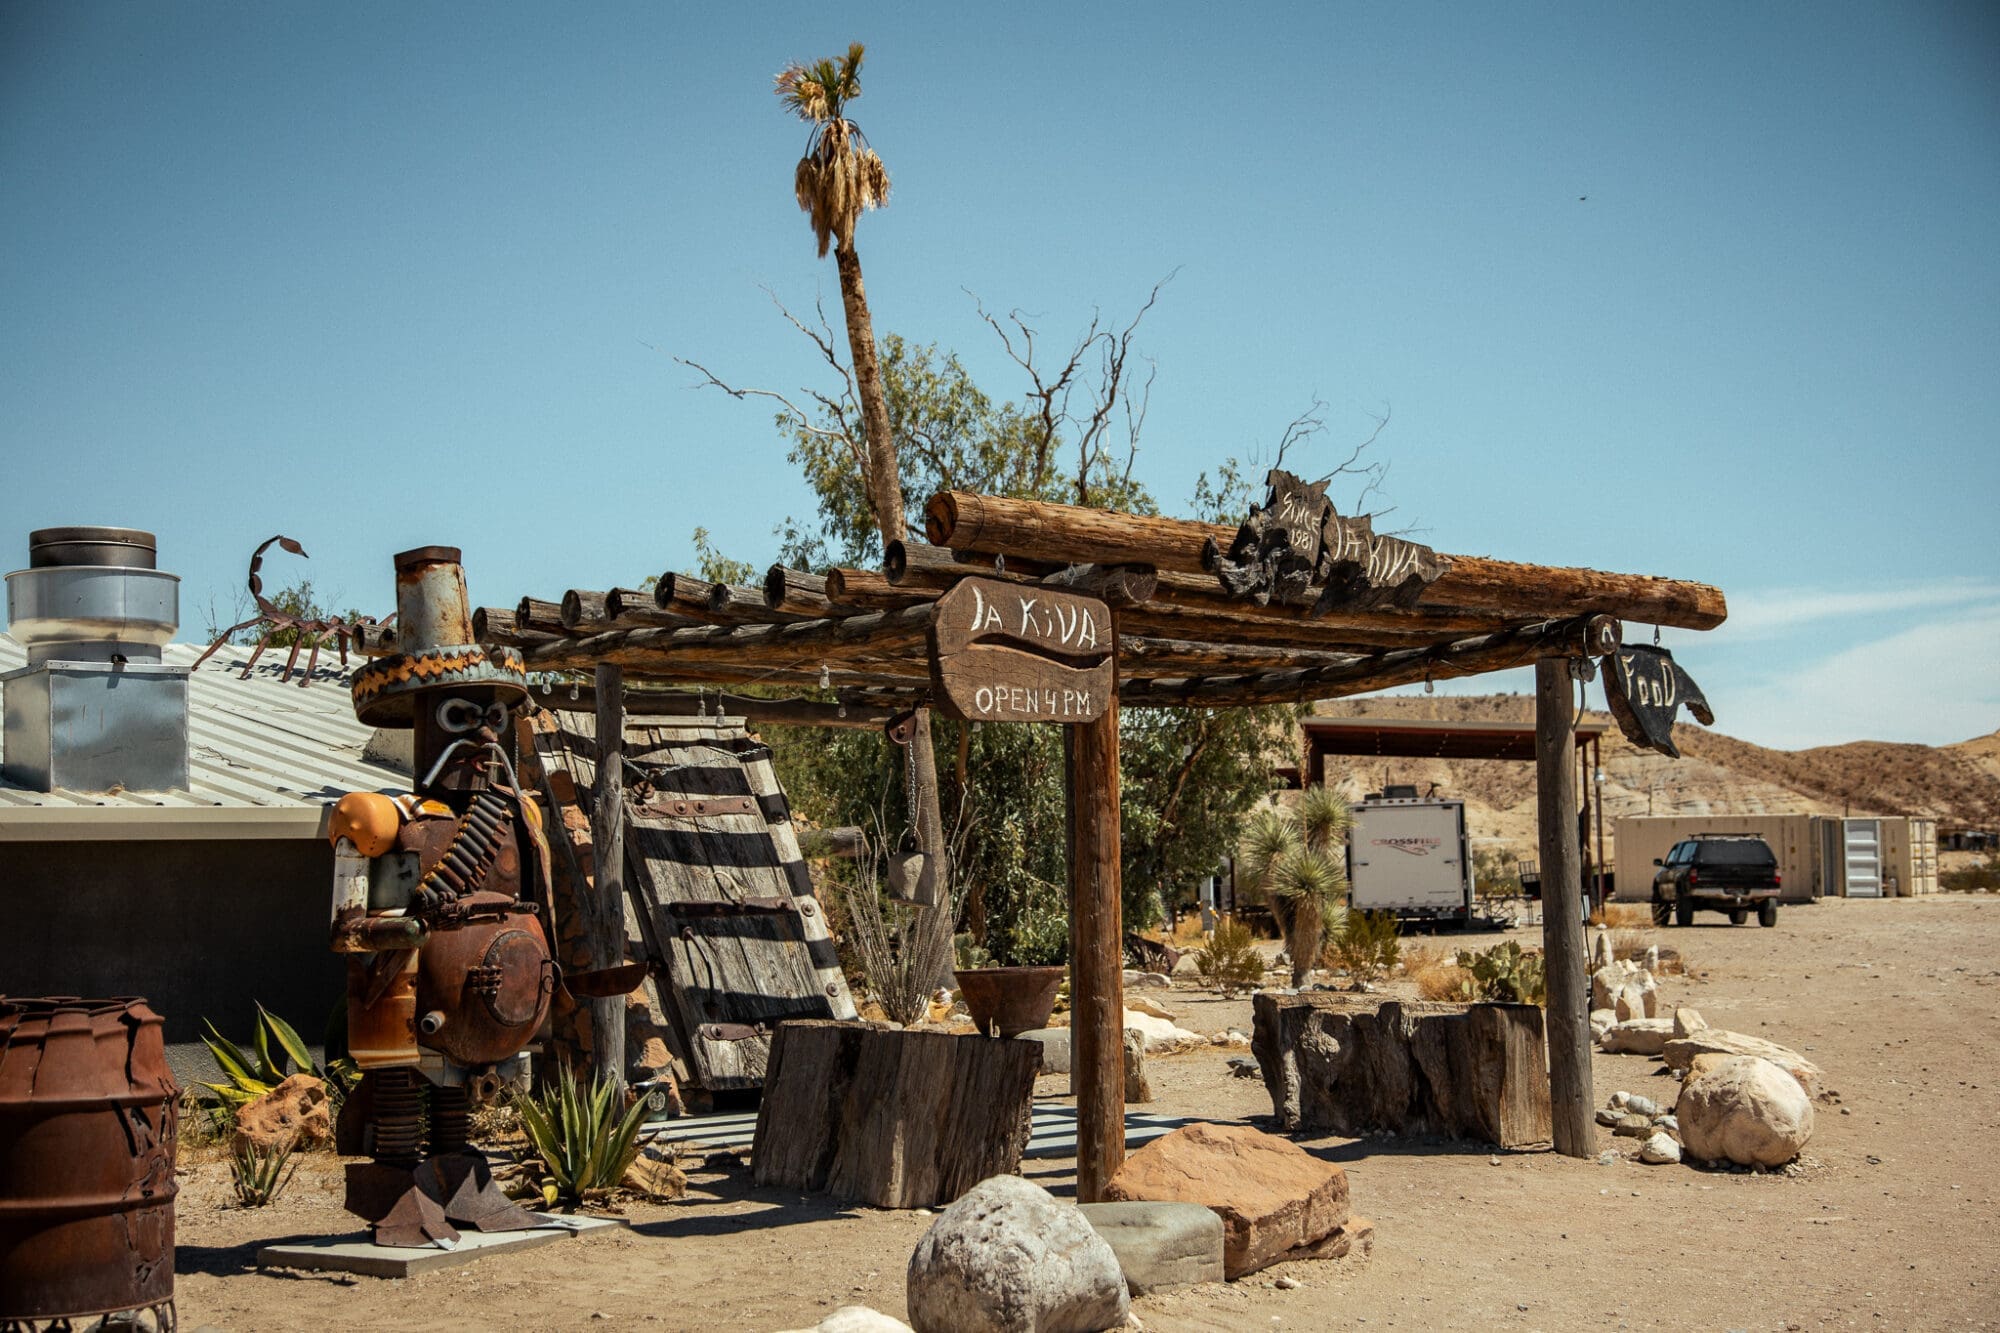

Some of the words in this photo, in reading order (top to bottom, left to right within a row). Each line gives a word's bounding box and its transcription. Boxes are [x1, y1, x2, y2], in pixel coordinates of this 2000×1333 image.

[1279, 491, 1322, 536] SINCE
[1290, 529, 1313, 551] 1981
[1365, 535, 1425, 583] KIVA
[975, 686, 1039, 715] OPEN
[1044, 688, 1058, 716] 4
[1062, 689, 1092, 716] PM
